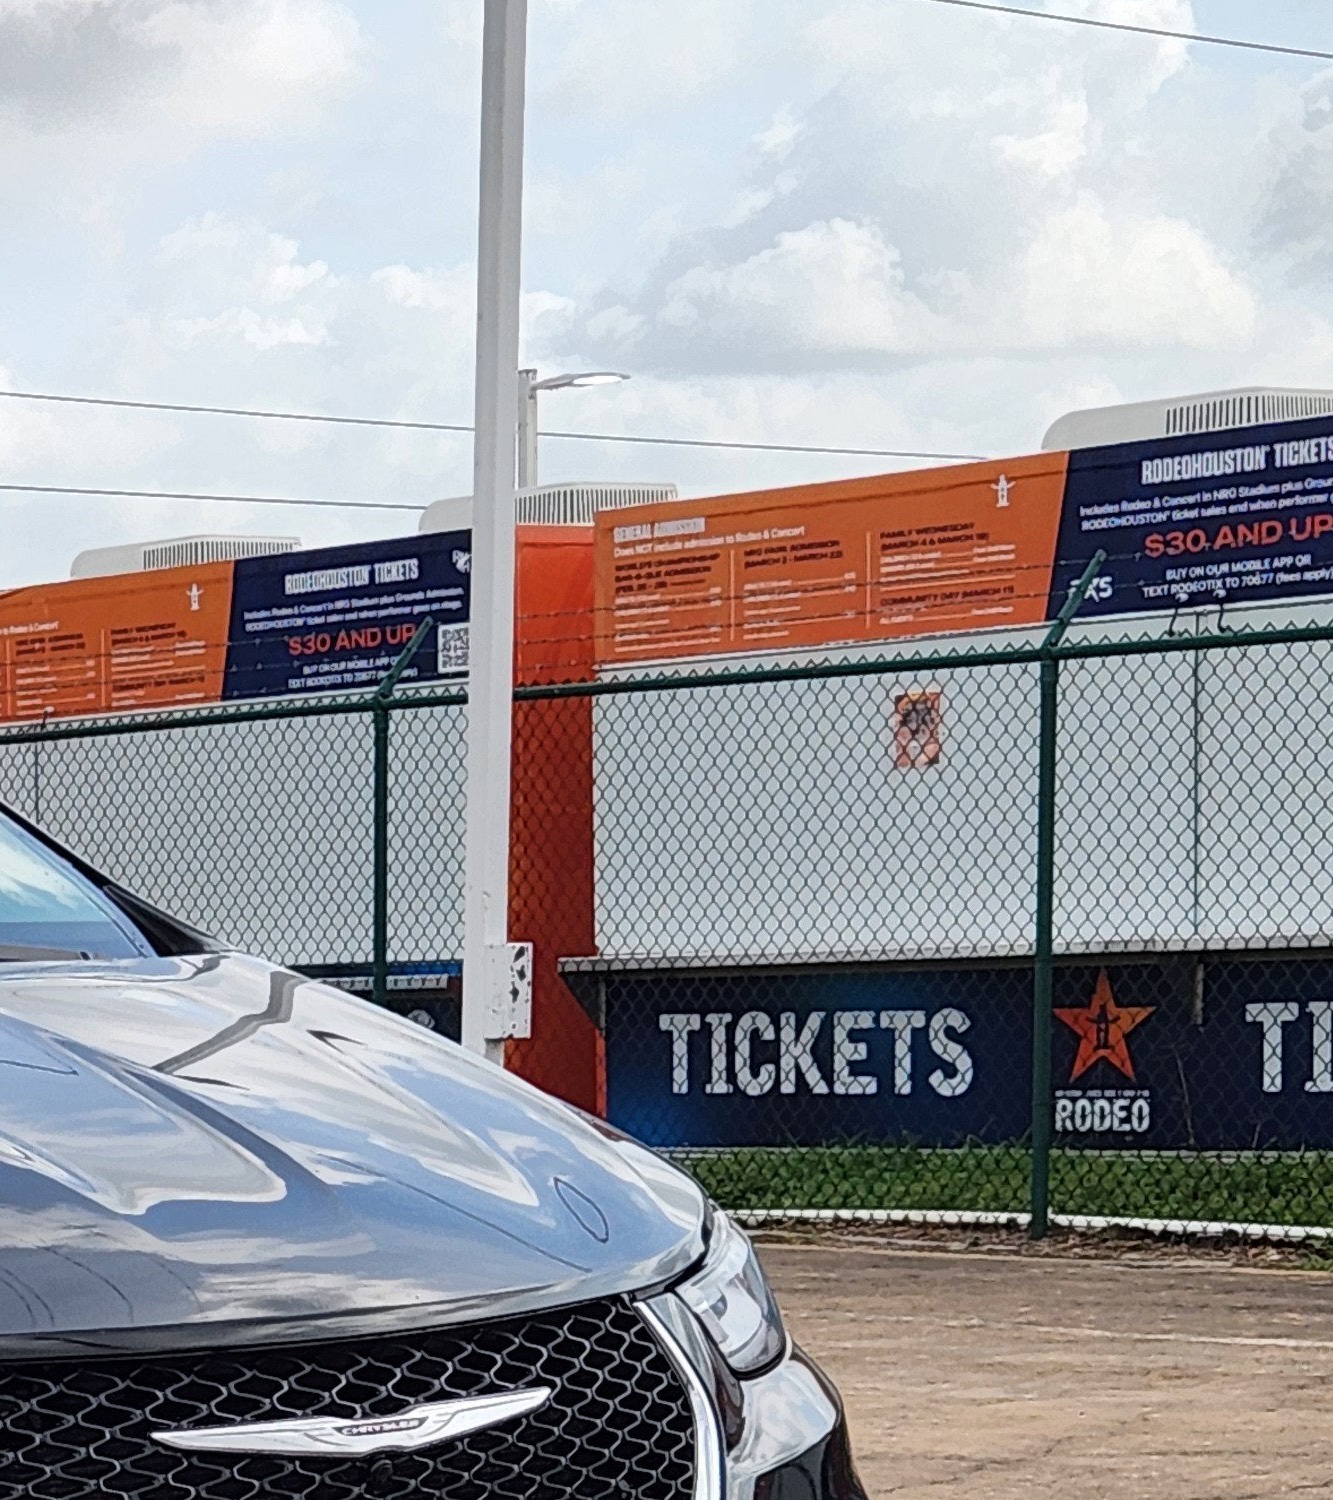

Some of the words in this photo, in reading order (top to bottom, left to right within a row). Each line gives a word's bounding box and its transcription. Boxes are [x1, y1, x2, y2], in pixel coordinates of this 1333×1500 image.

[1144, 528, 1207, 558] $30
[1213, 519, 1283, 551] AND
[1289, 514, 1333, 541] UP
[335, 626, 383, 650] AND
[659, 1007, 975, 1096] TICKETS
[1055, 1098, 1150, 1132] RODEO
